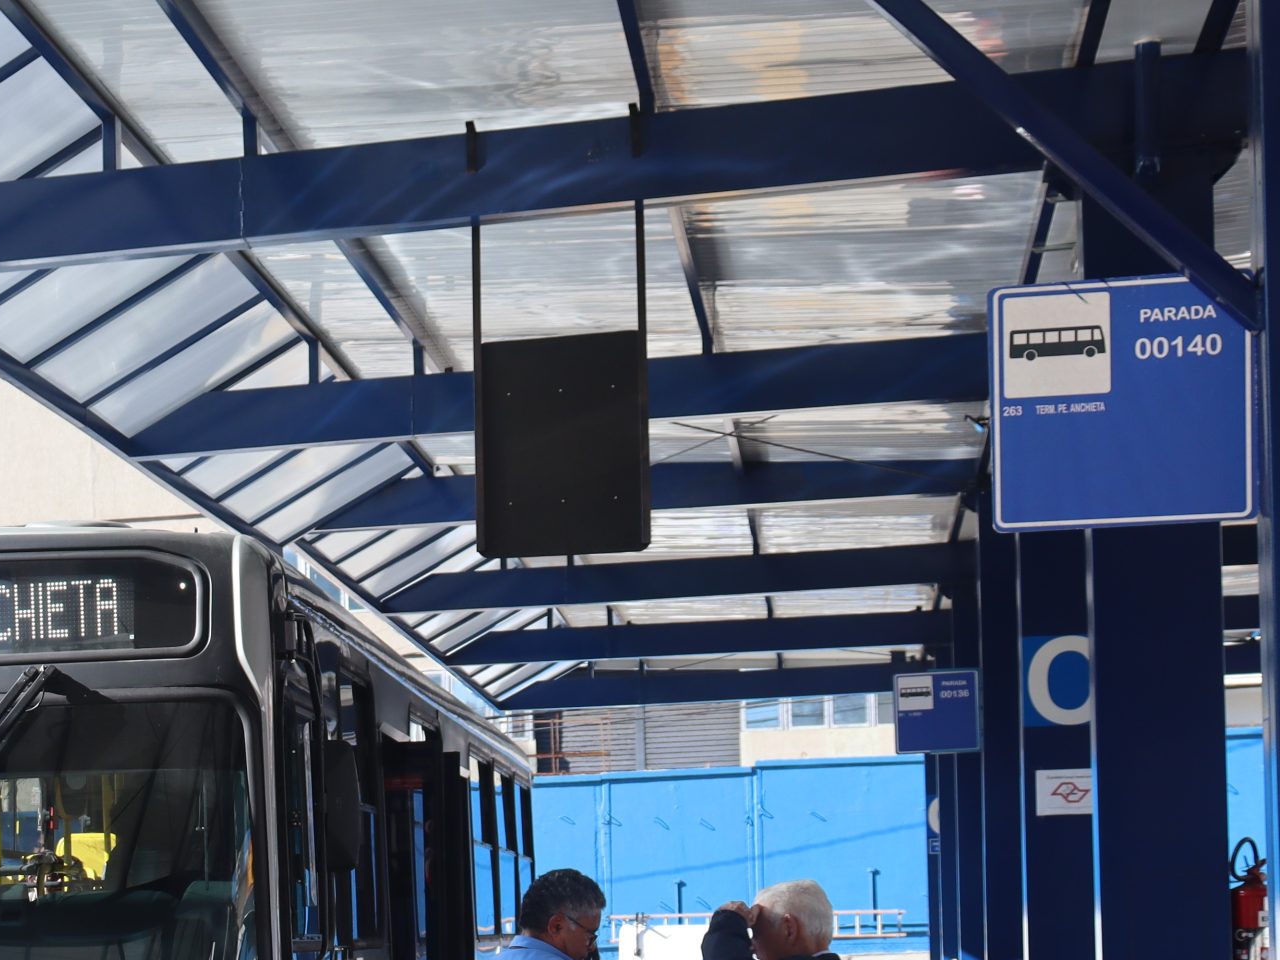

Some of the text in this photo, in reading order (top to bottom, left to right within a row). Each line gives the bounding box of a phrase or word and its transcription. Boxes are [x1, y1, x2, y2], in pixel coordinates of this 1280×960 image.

[1140, 304, 1217, 323] PARADA
[1134, 333, 1223, 360] 00140
[1003, 405, 1023, 416] 263
